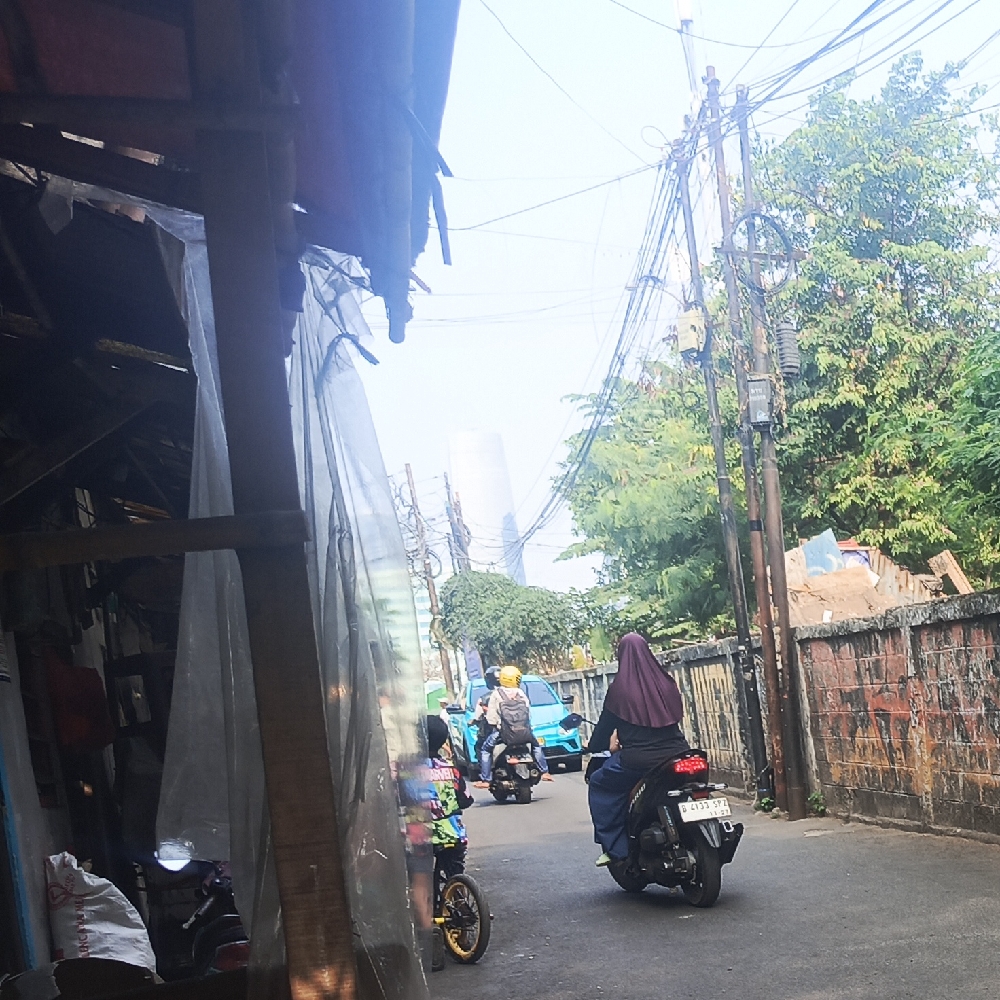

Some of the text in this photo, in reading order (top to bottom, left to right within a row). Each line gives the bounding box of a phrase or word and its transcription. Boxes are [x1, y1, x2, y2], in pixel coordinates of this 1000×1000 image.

[681, 799, 728, 813] B 4133 SPZ
